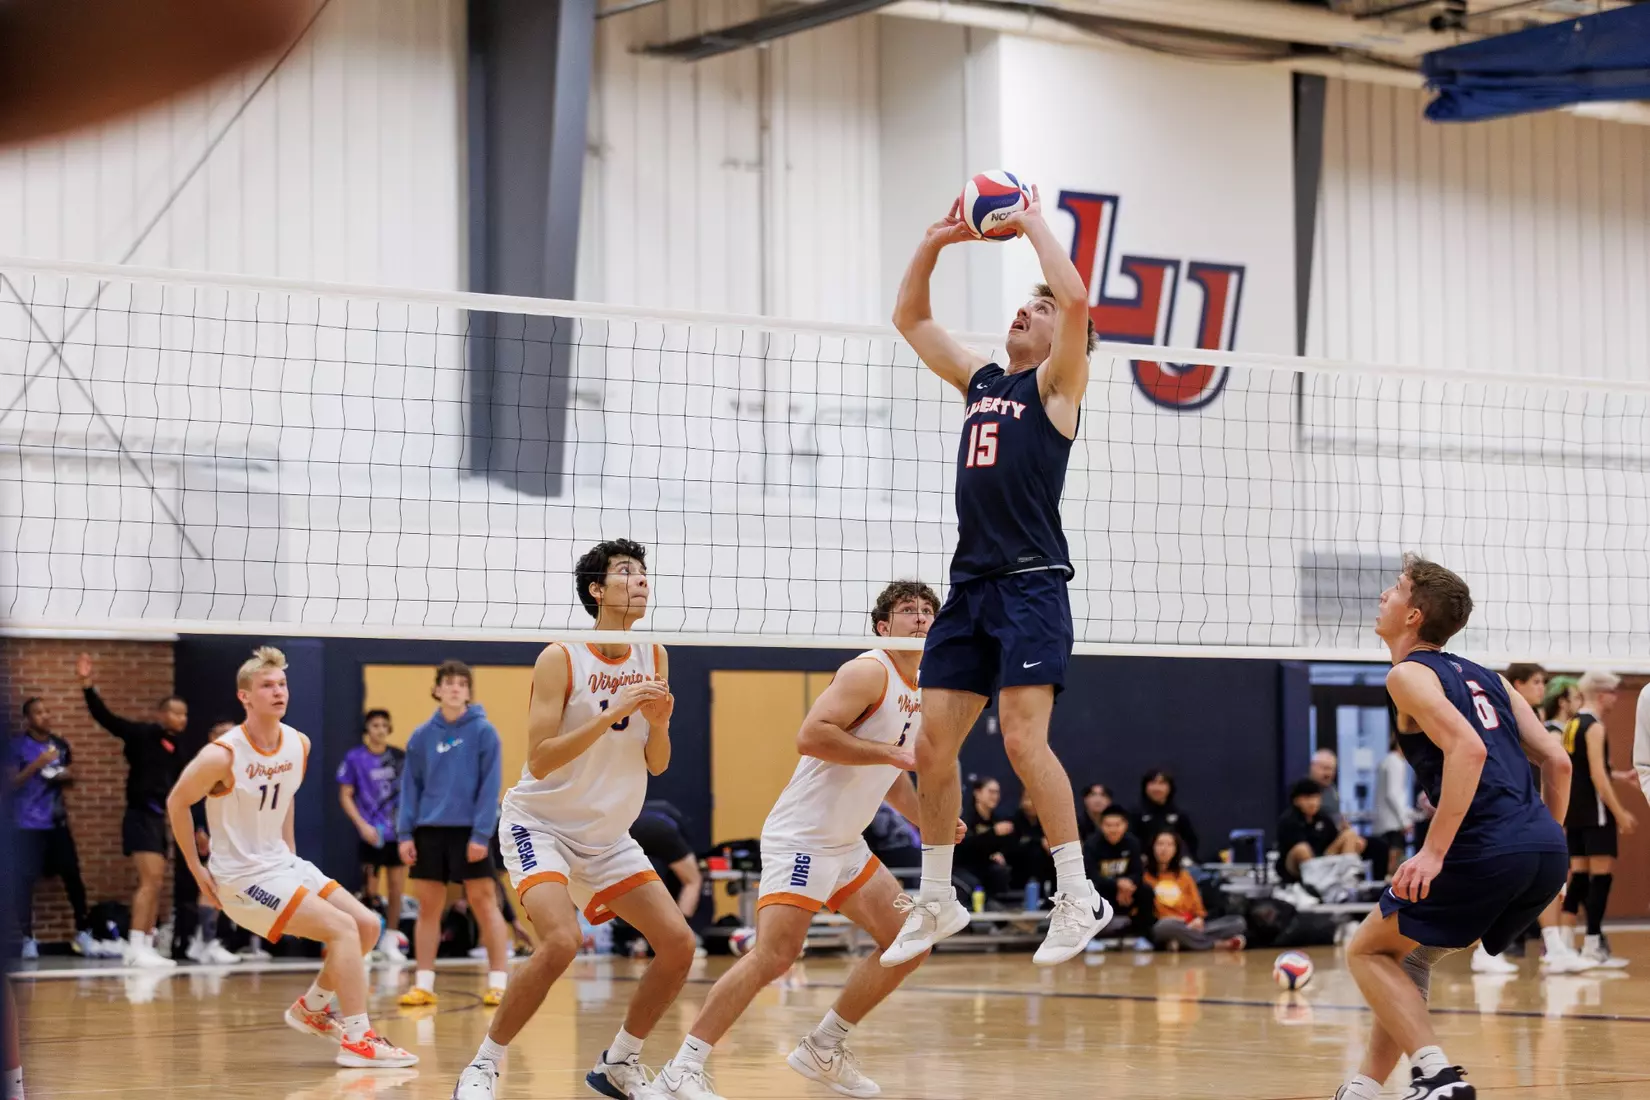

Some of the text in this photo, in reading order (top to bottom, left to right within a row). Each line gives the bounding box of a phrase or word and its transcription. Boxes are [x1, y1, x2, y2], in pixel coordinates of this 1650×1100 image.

[1057, 190, 1246, 412] LU
[966, 421, 999, 468] 15
[588, 669, 644, 695] Virginia
[1465, 680, 1499, 731] 6
[894, 721, 911, 747] 5
[245, 760, 293, 780] Virginia
[259, 782, 280, 811] 11
